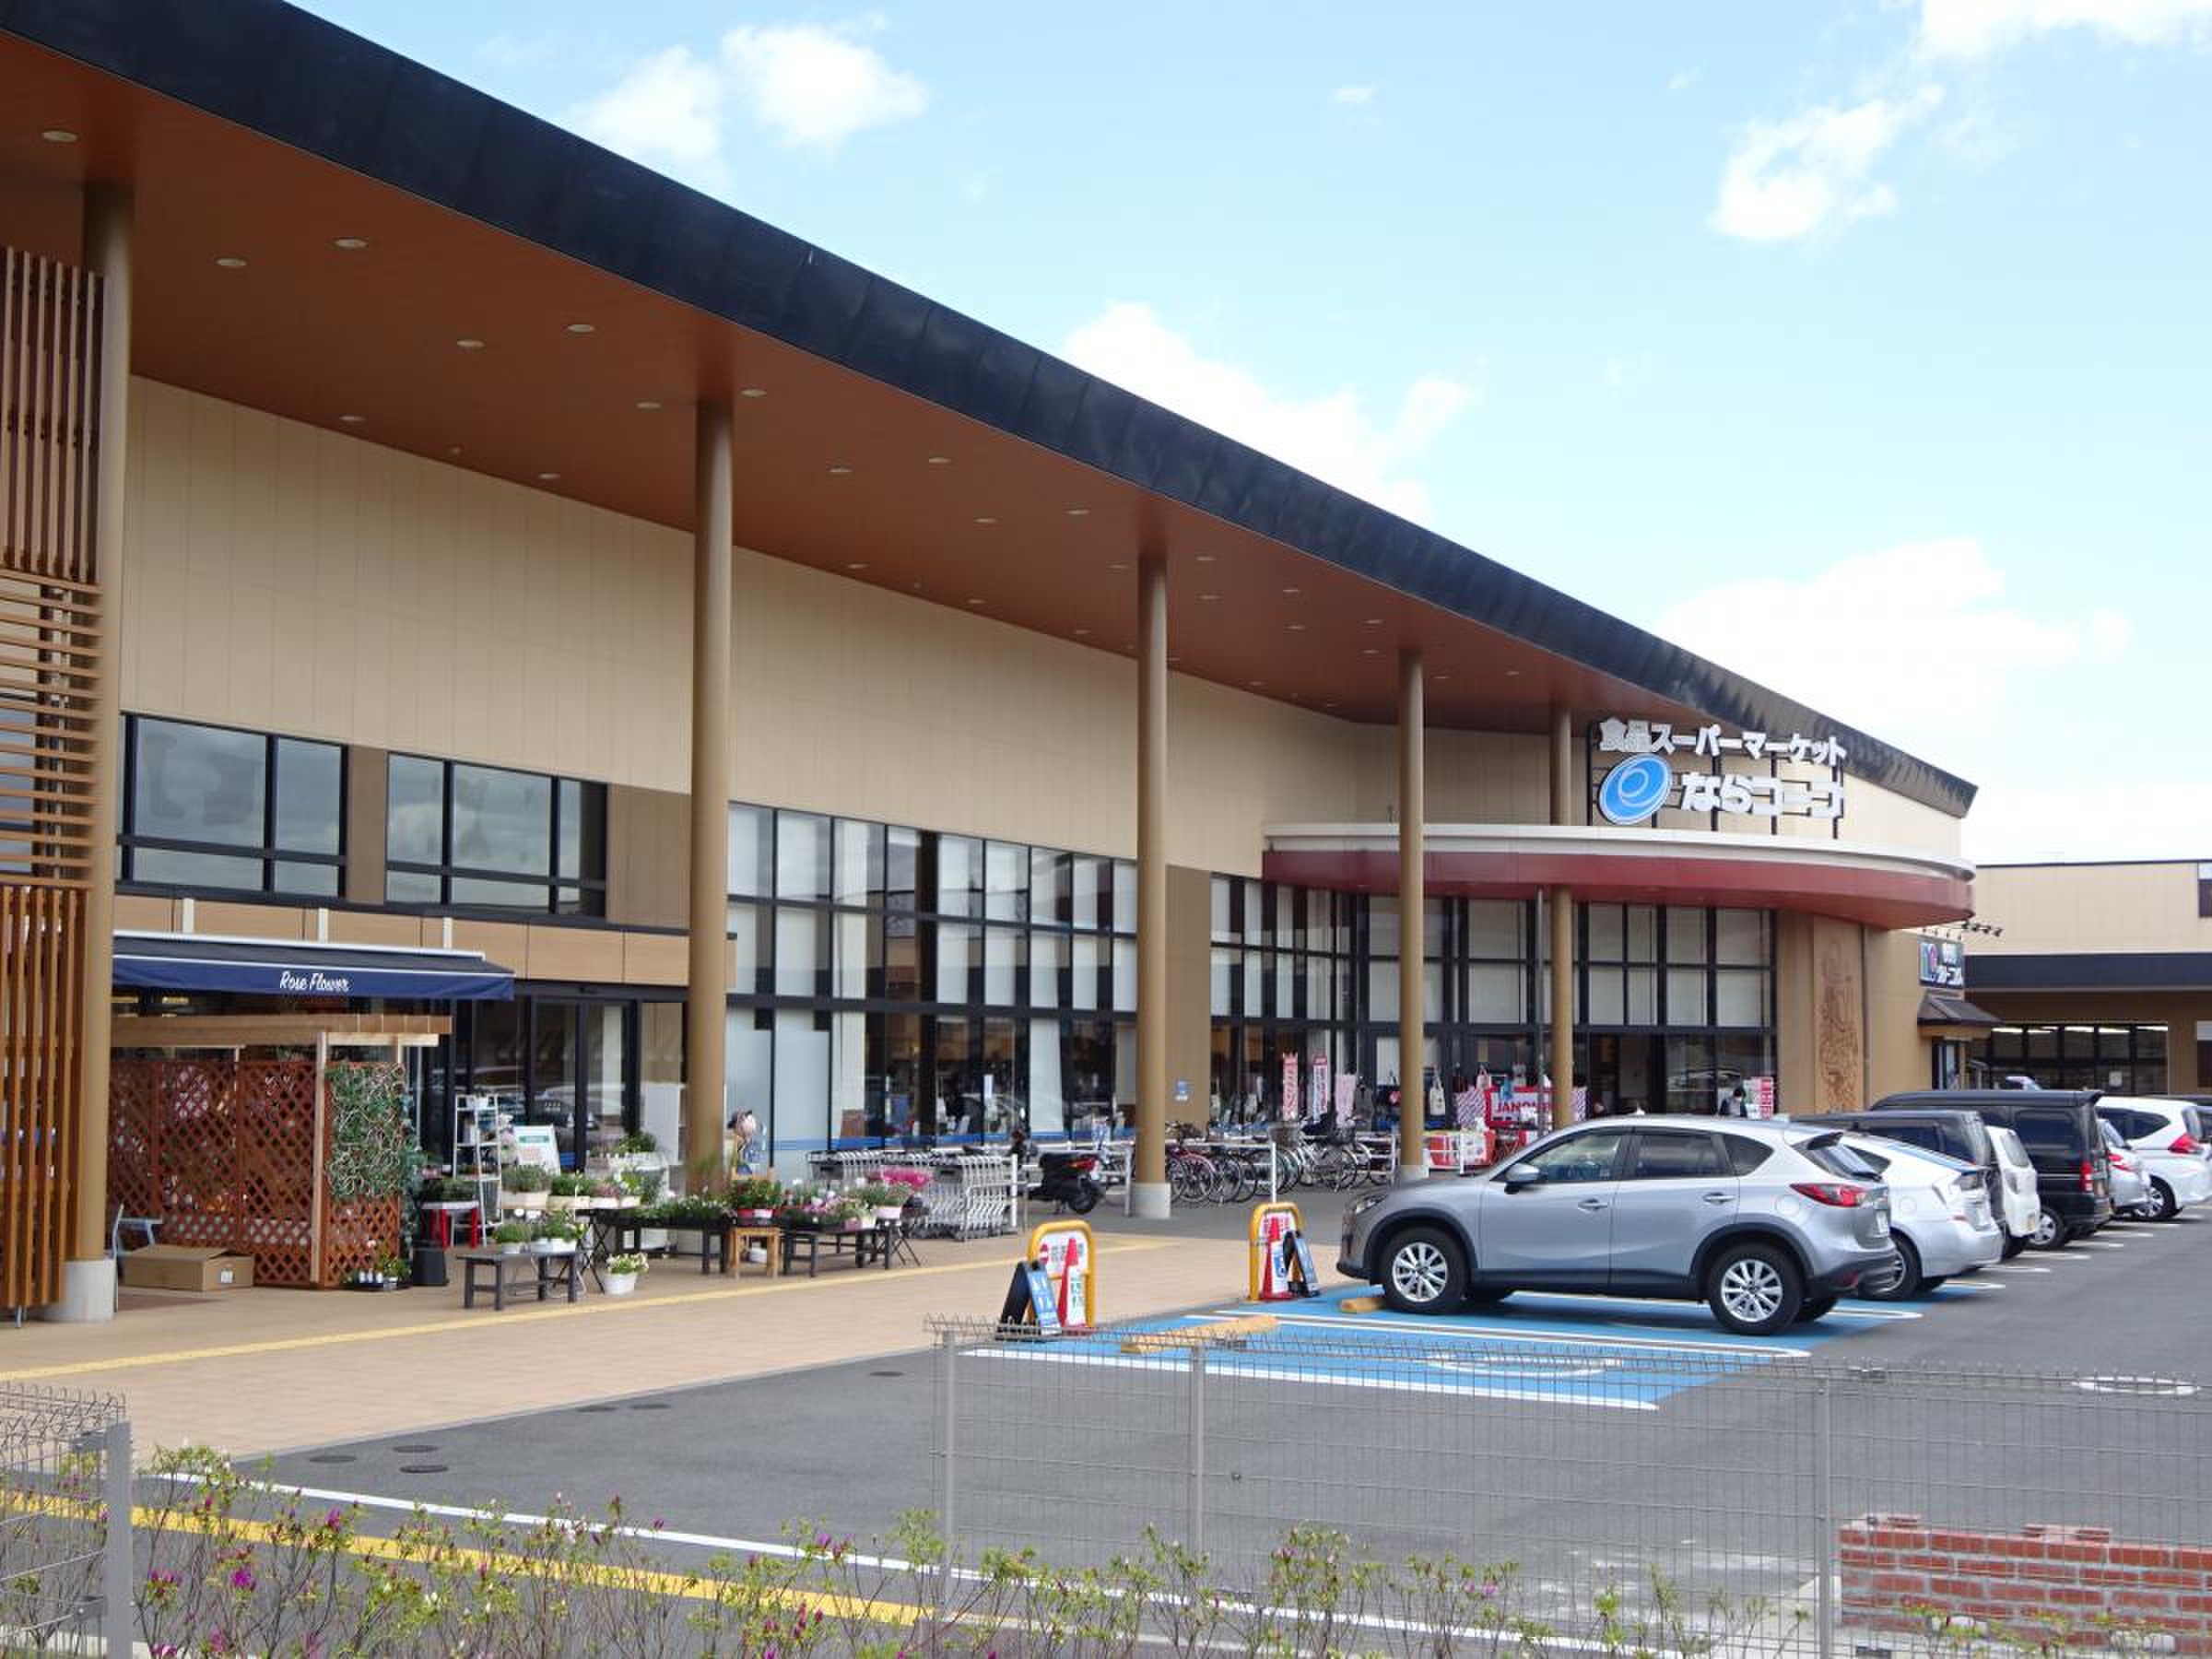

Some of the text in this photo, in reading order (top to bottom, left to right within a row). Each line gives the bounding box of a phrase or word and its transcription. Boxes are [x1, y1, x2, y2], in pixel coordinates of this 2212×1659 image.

[1599, 717, 1847, 767] 食品スーパーマーケット
[279, 971, 308, 991] Rose
